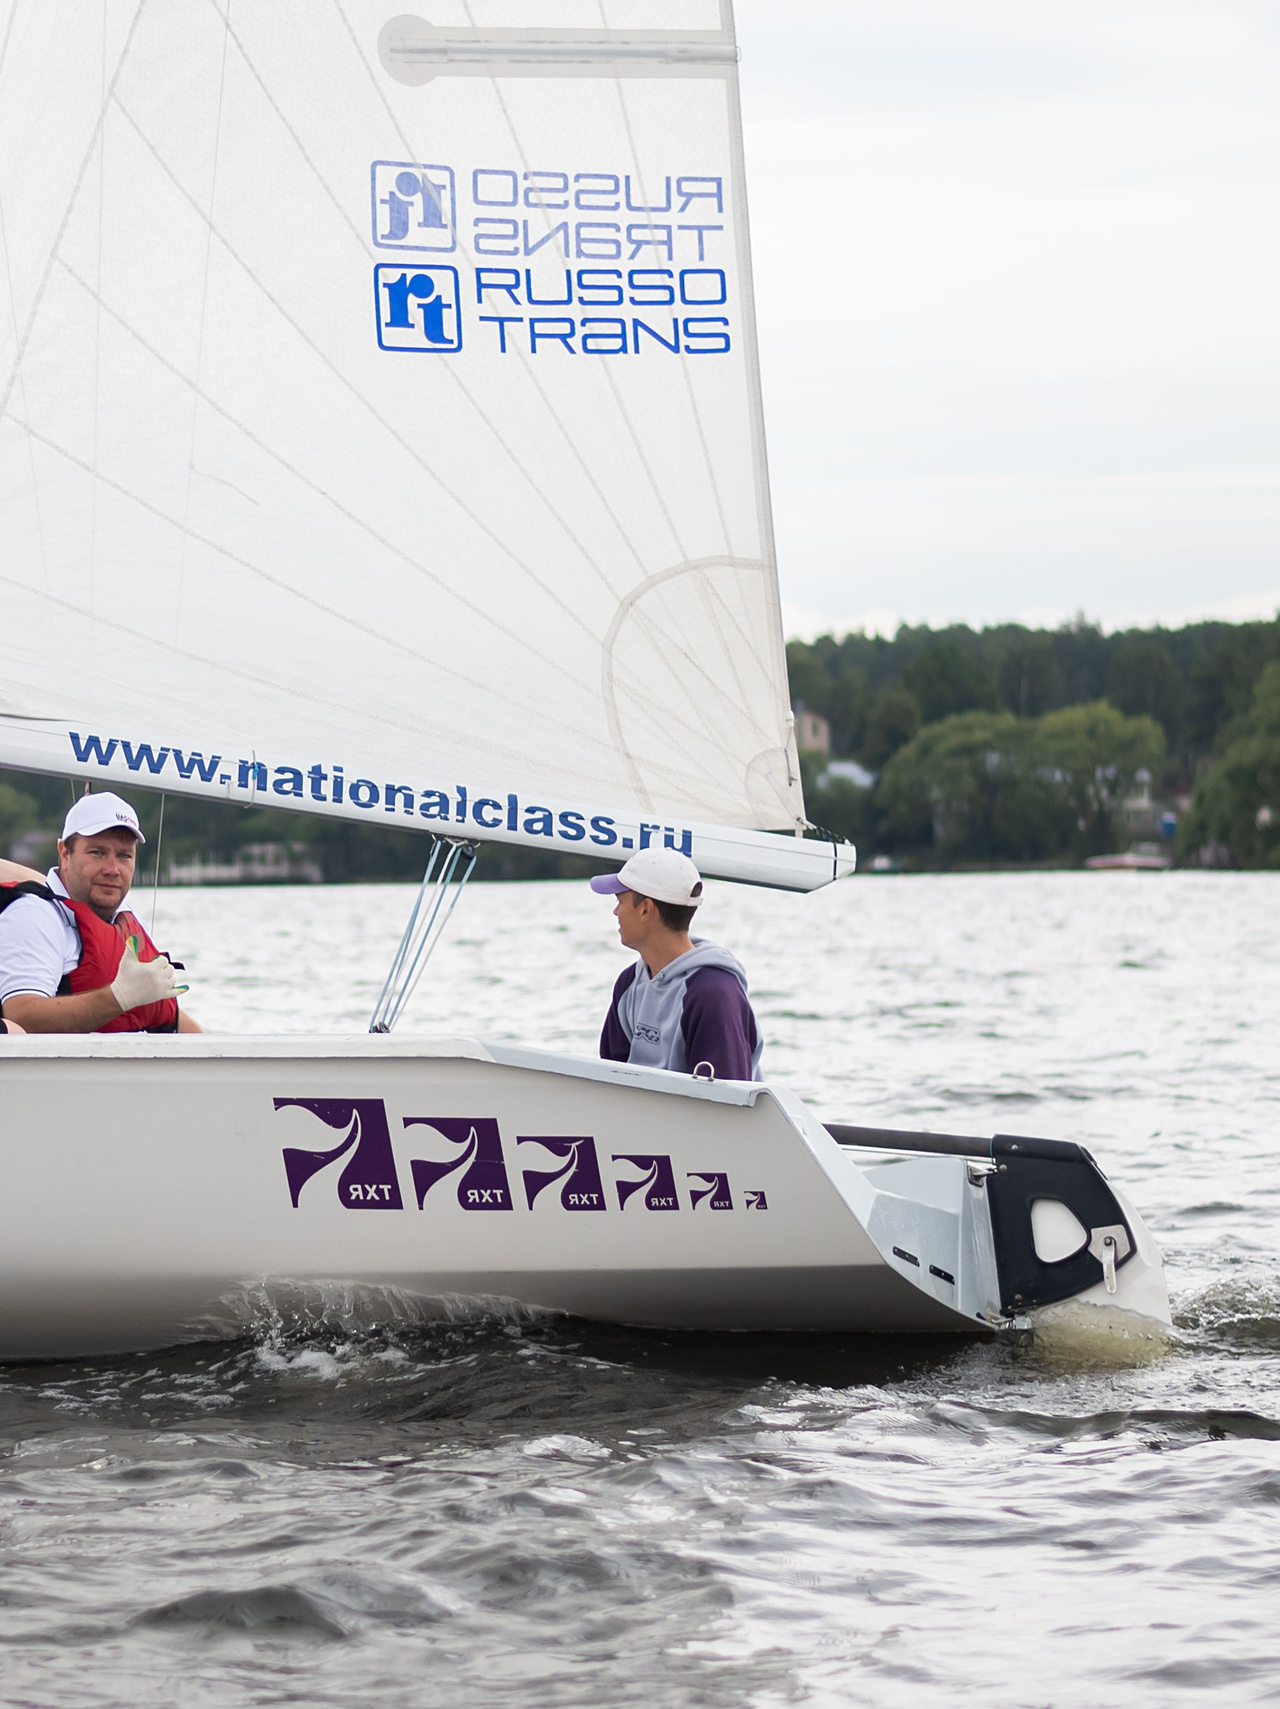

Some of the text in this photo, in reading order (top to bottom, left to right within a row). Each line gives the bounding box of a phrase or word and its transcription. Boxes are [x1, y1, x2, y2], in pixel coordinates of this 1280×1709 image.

[475, 267, 727, 306] RUSSO
[68, 731, 693, 857] www.nationalclass.ru
[348, 1184, 392, 1201] ЯХТ
[466, 1189, 504, 1203] ЯХТ
[568, 1193, 599, 1205] ЯХТ
[650, 1197, 674, 1206] ЯХТ
